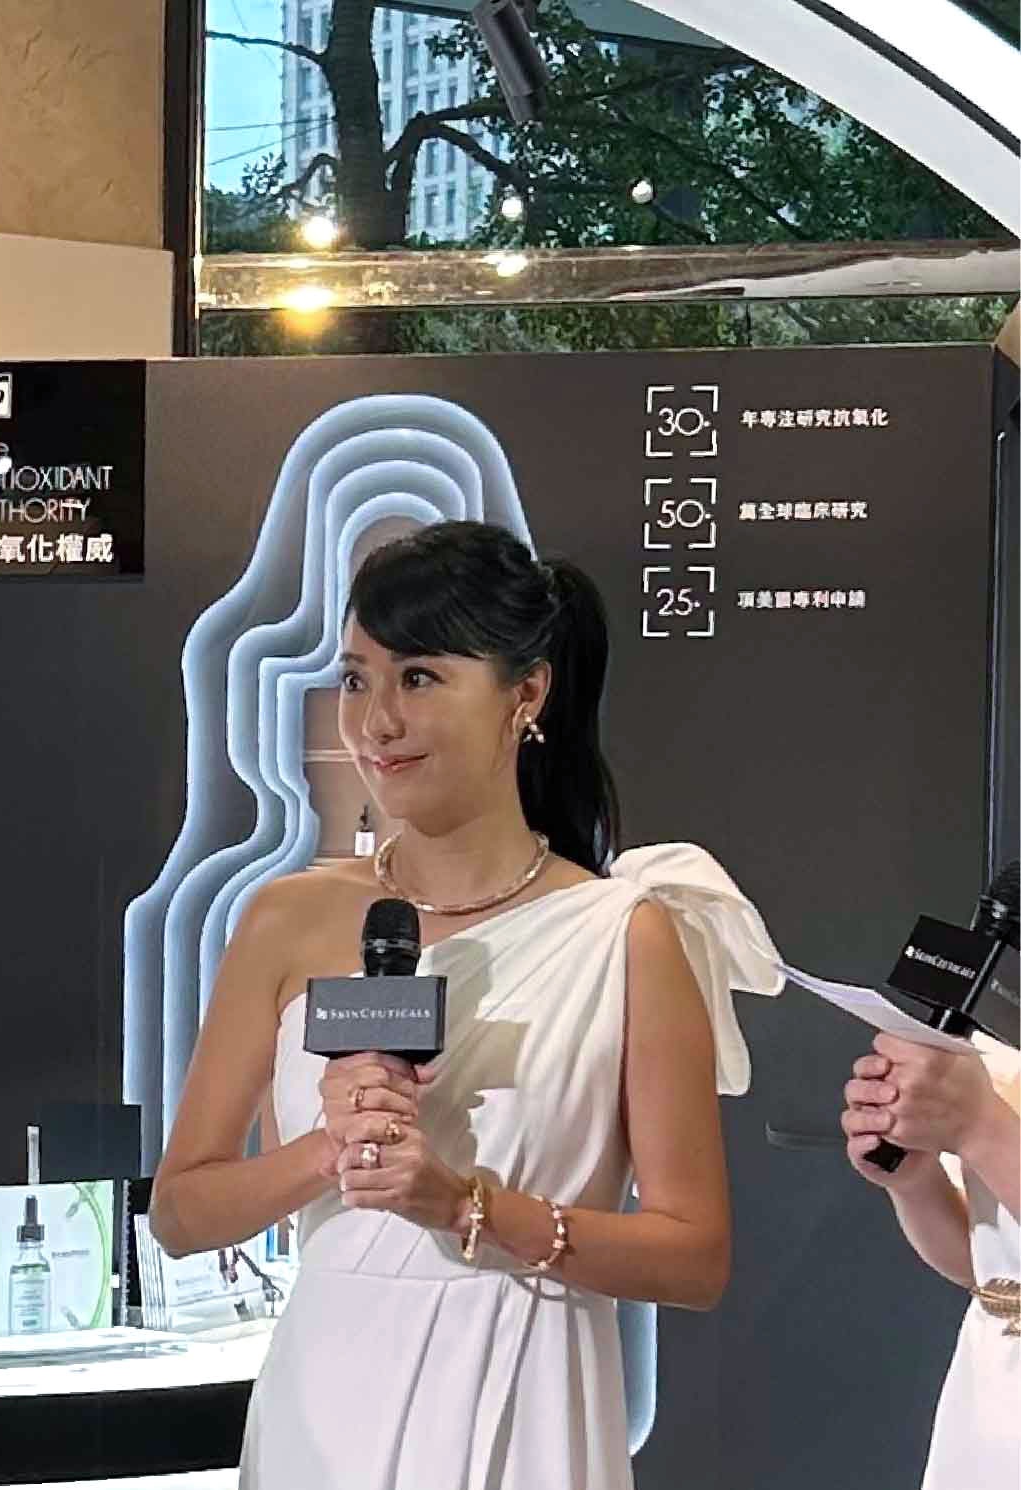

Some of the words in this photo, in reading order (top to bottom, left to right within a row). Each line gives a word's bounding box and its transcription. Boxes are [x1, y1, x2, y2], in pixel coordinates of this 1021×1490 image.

[739, 408, 890, 429] 年專注研究抗氧化
